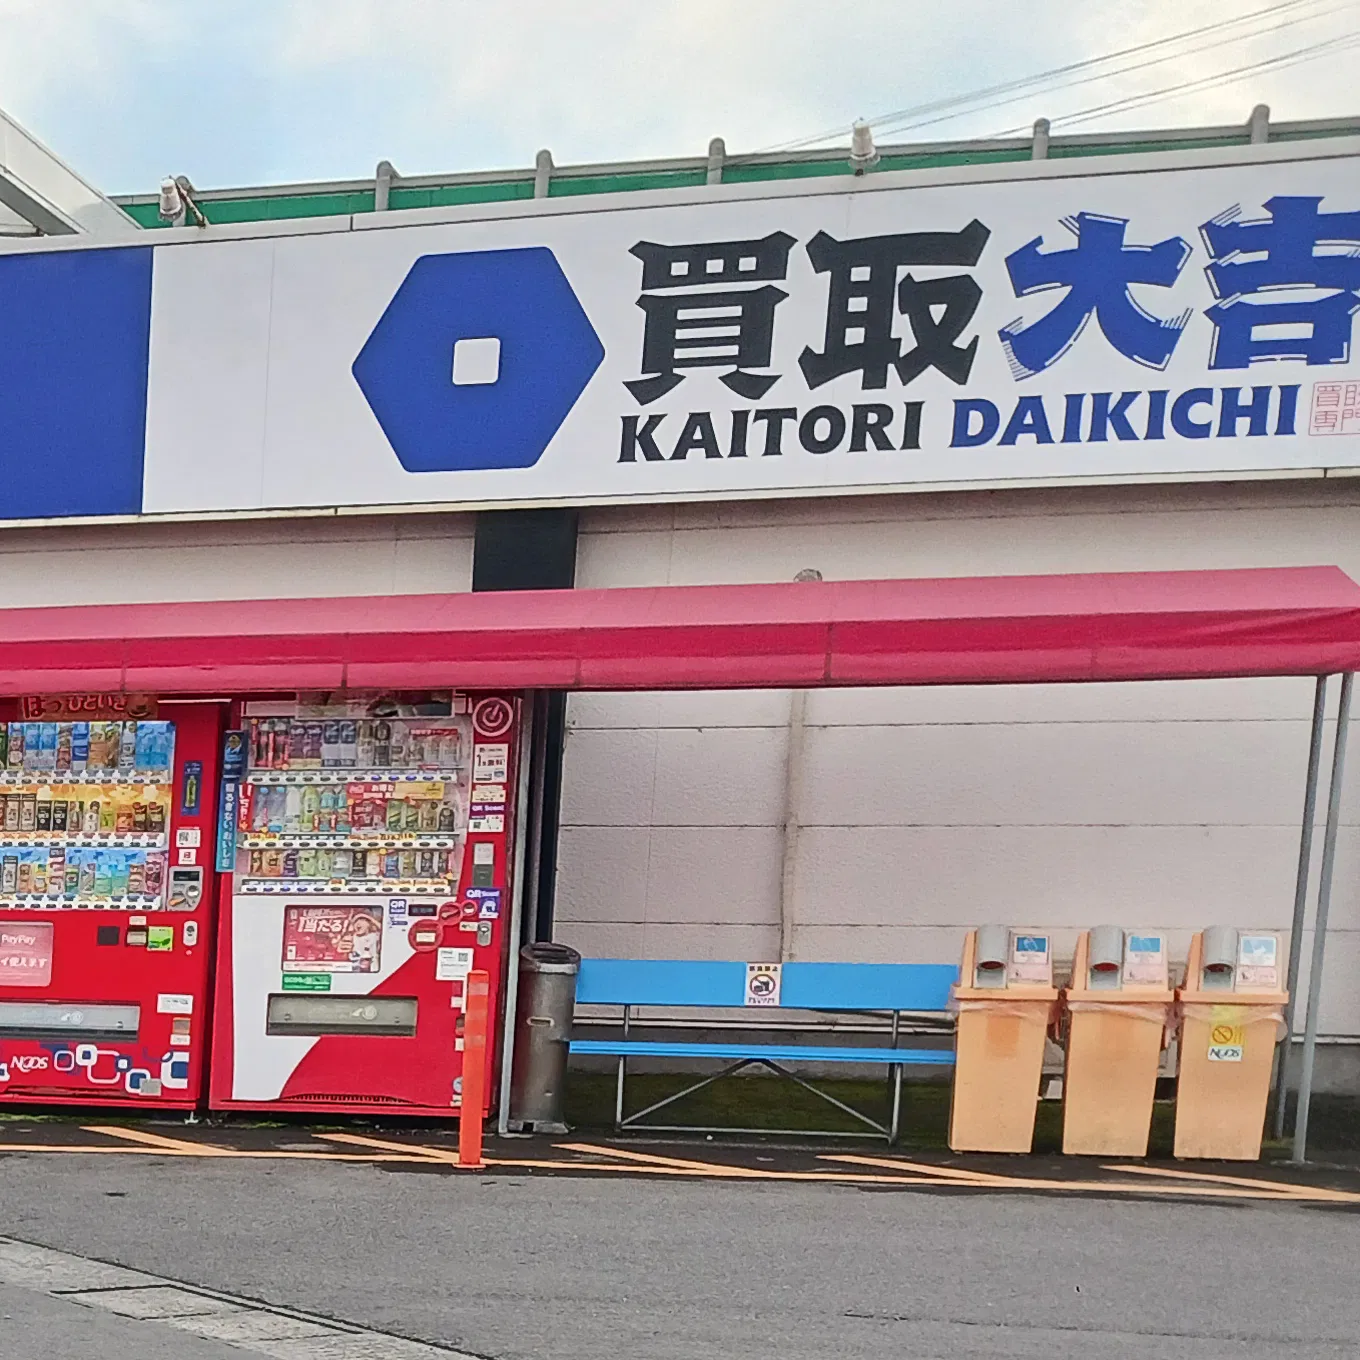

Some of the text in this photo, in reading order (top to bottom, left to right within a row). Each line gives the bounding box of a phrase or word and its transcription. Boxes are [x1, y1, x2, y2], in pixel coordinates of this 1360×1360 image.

[617, 384, 1302, 463] KAITORI DAIKICHI
[1, 934, 36, 945] PayPay
